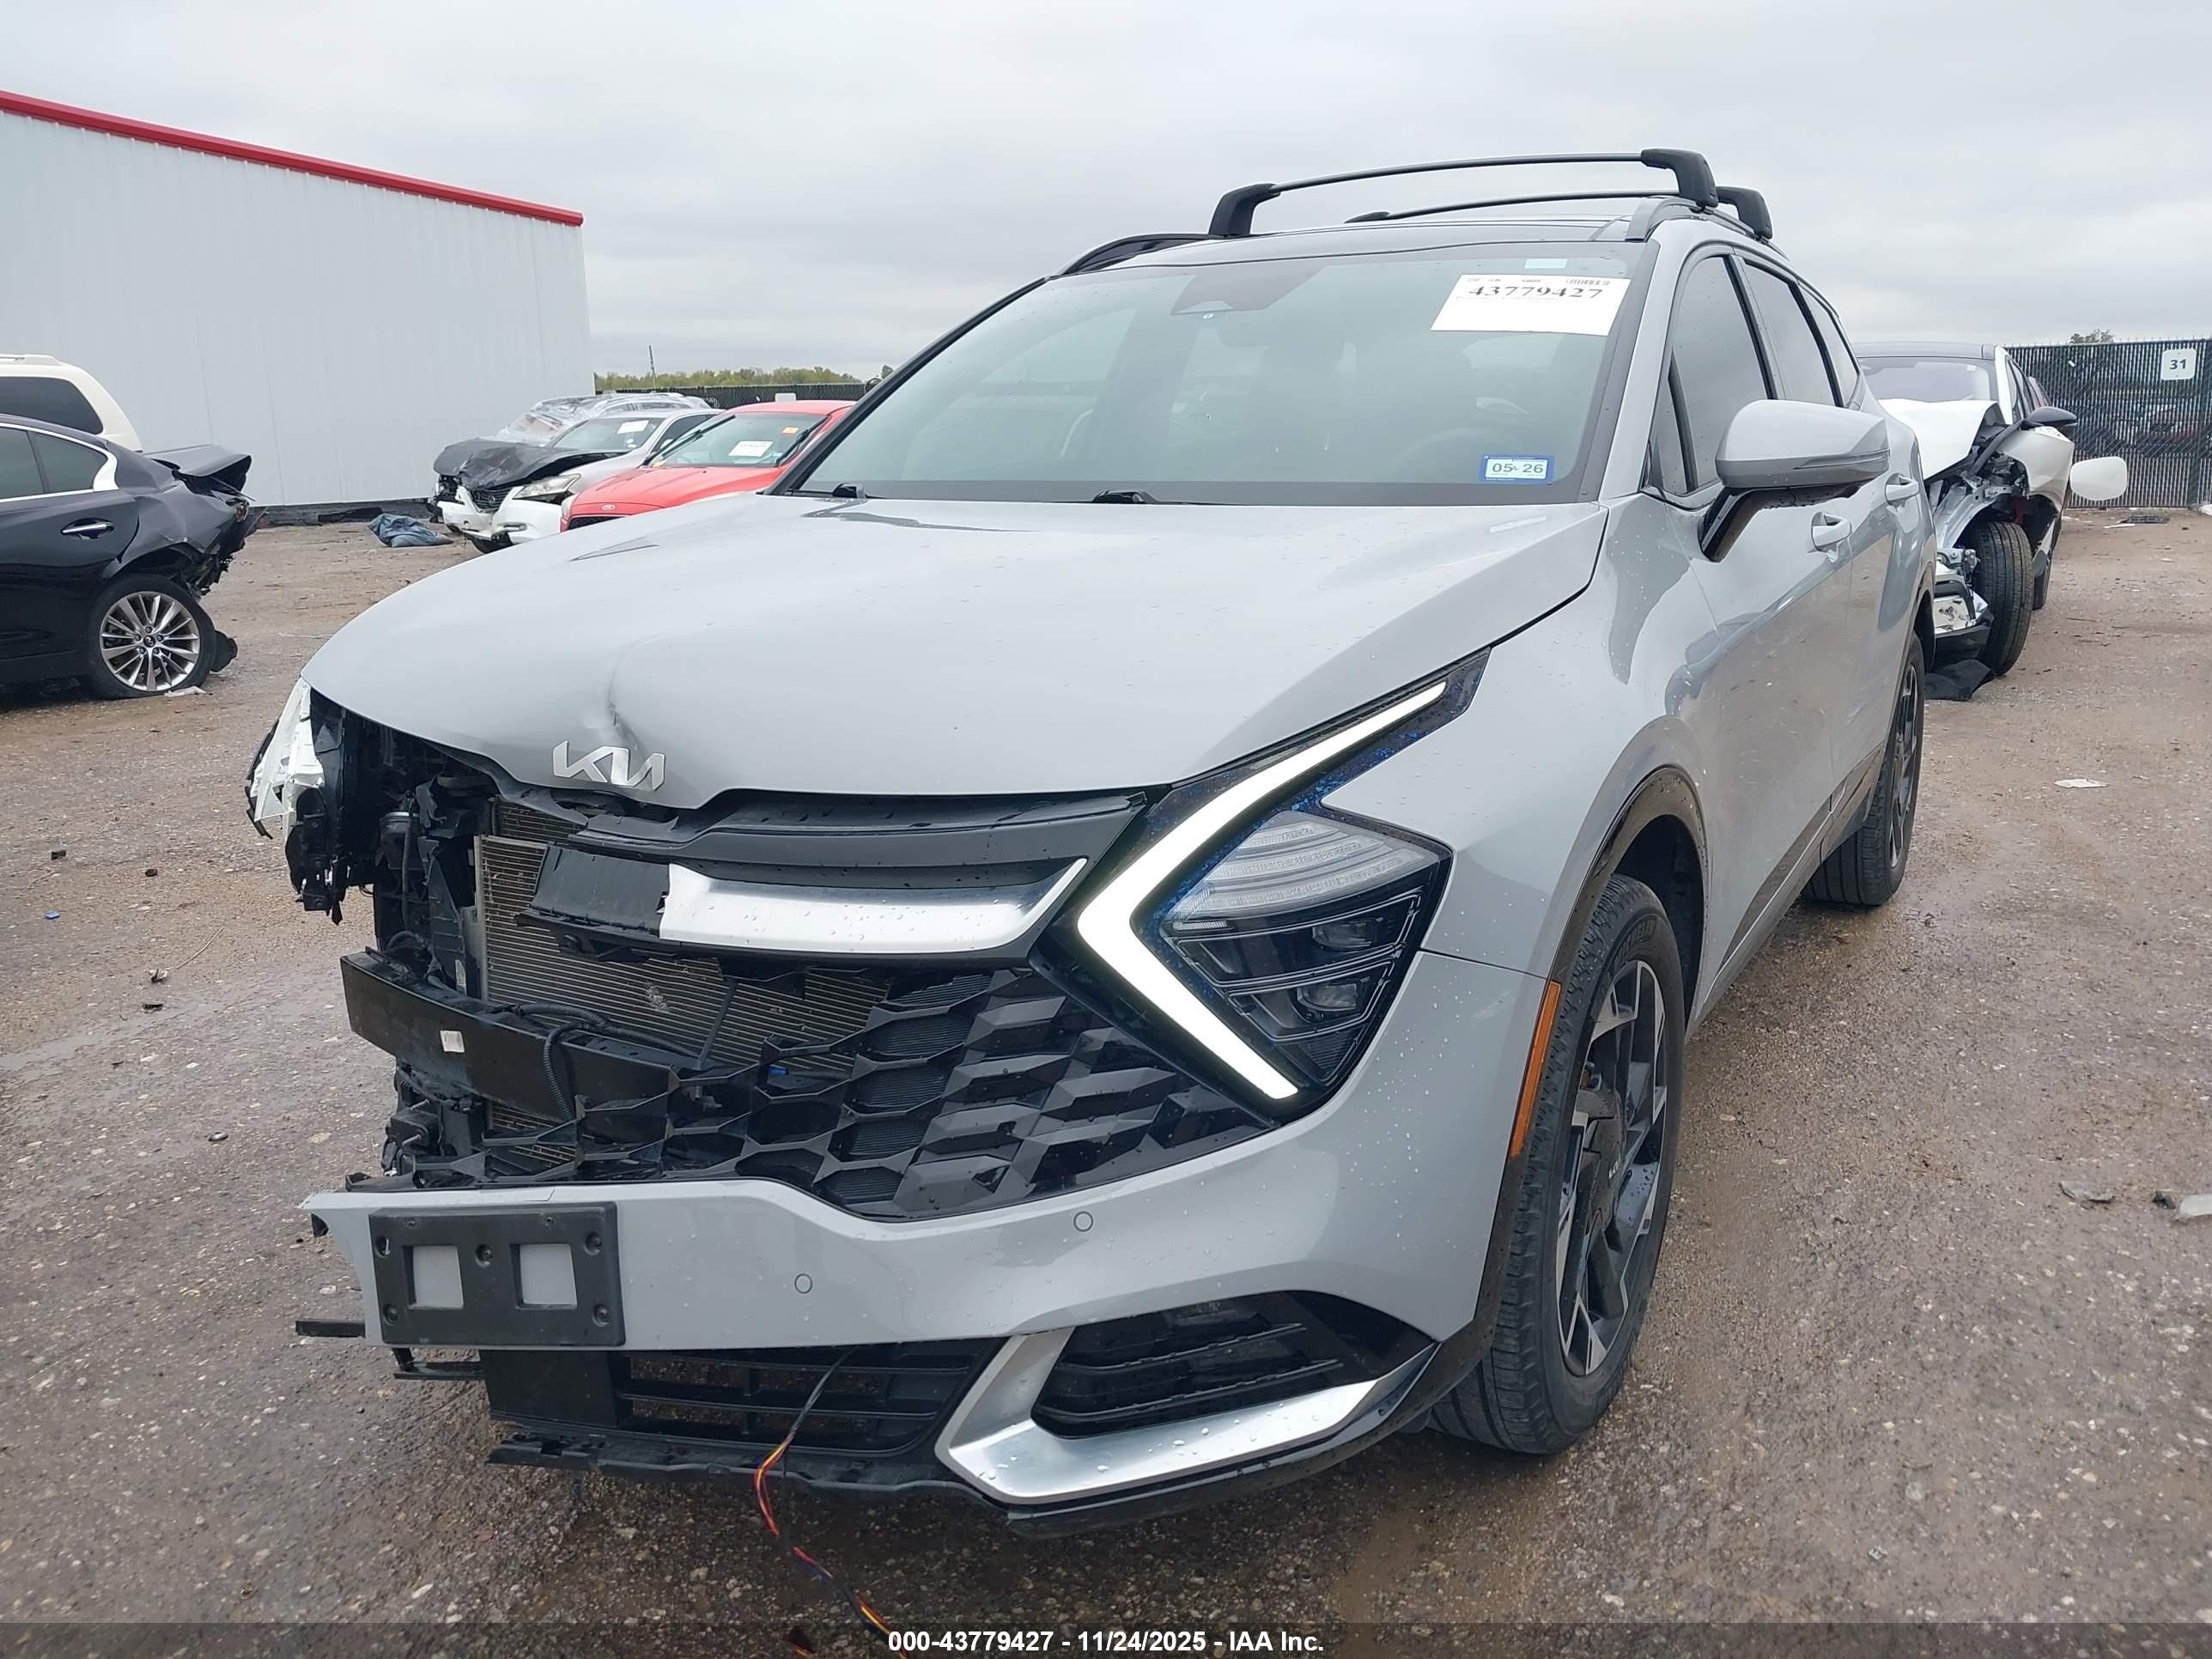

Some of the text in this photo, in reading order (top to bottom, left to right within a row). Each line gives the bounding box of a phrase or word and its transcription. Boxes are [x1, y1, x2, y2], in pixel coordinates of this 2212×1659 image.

[1468, 286, 1603, 299] 43779427
[2169, 359, 2187, 370] 31
[552, 740, 665, 791] KIA
